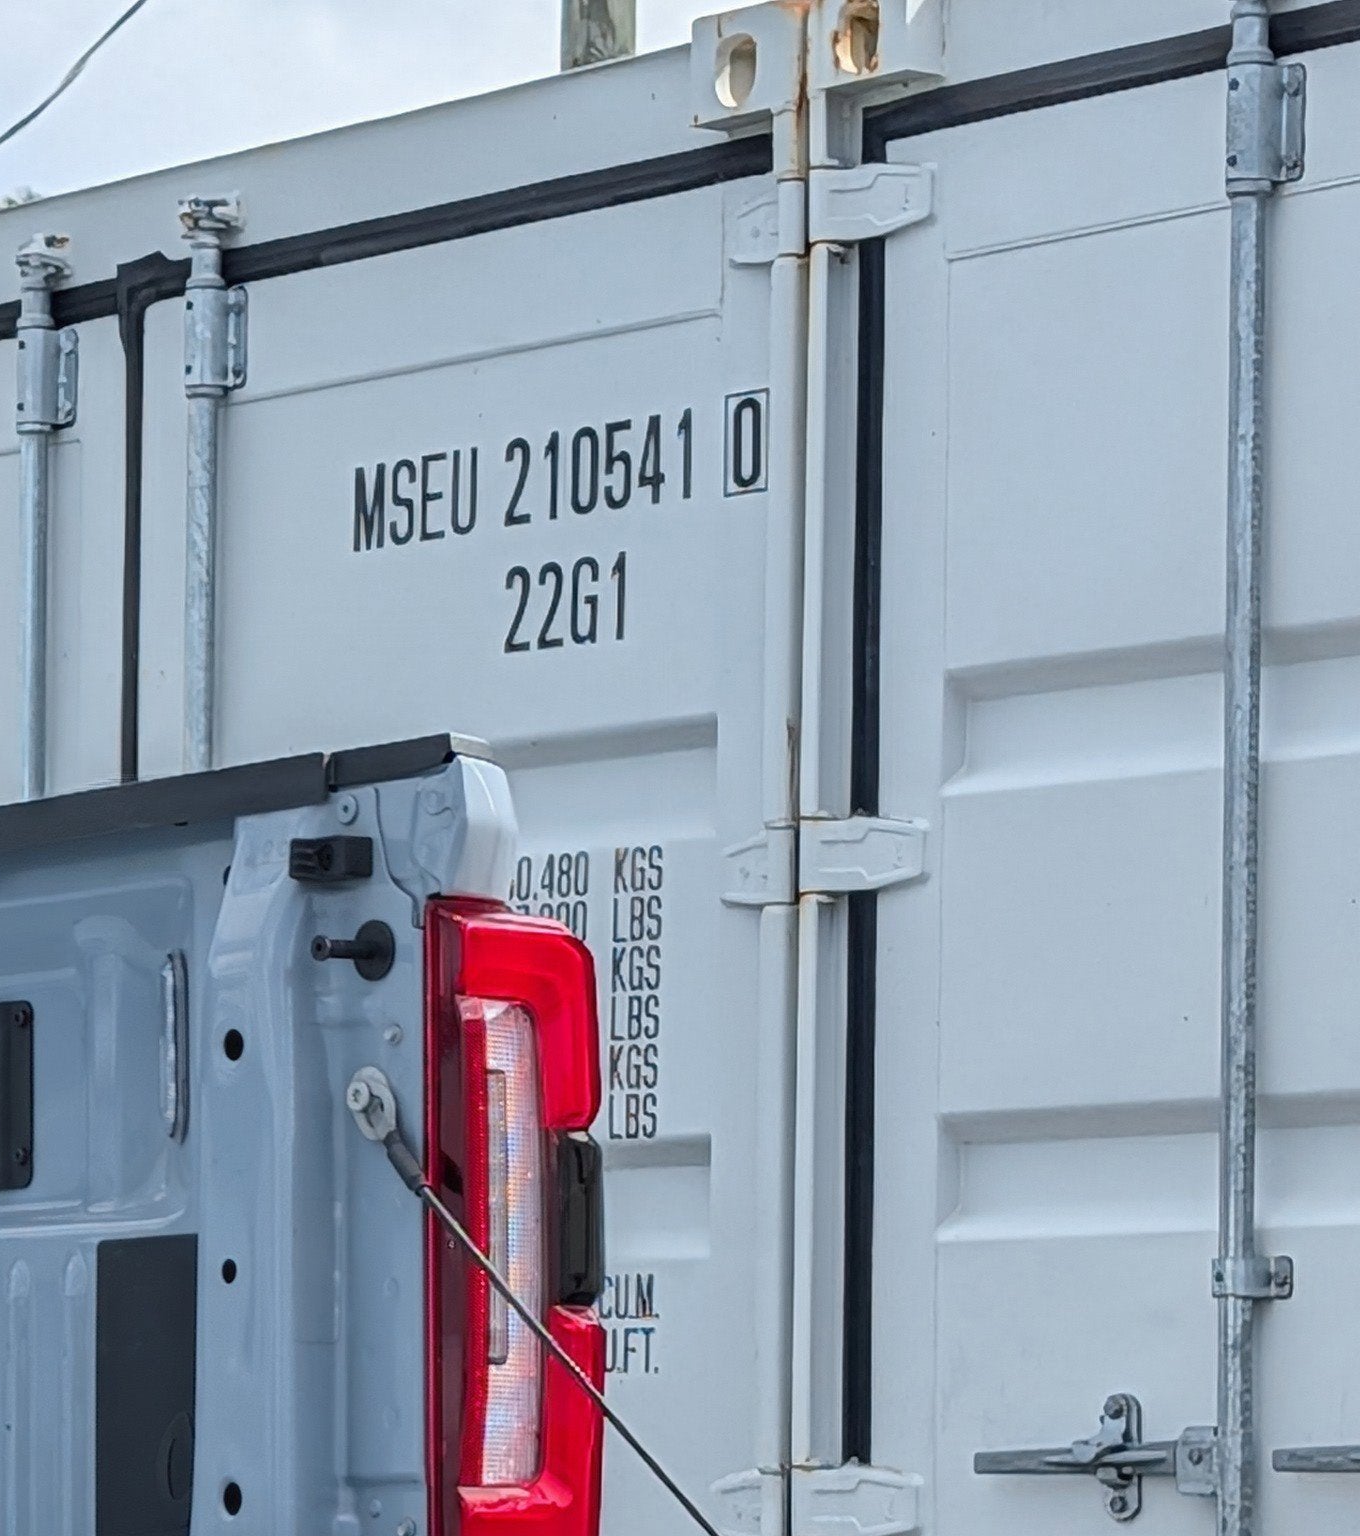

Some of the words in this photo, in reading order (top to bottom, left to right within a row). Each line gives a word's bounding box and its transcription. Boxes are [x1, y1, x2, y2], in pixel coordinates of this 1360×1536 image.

[352, 446, 478, 553] MSEU
[503, 406, 694, 528] 210541
[503, 550, 628, 654] 22G1
[612, 844, 664, 895] KGS
[611, 895, 664, 944] LBS
[610, 944, 662, 993] KGS
[608, 993, 661, 1041] LBS
[608, 1043, 659, 1091] KGS
[607, 1092, 658, 1141] LBS
